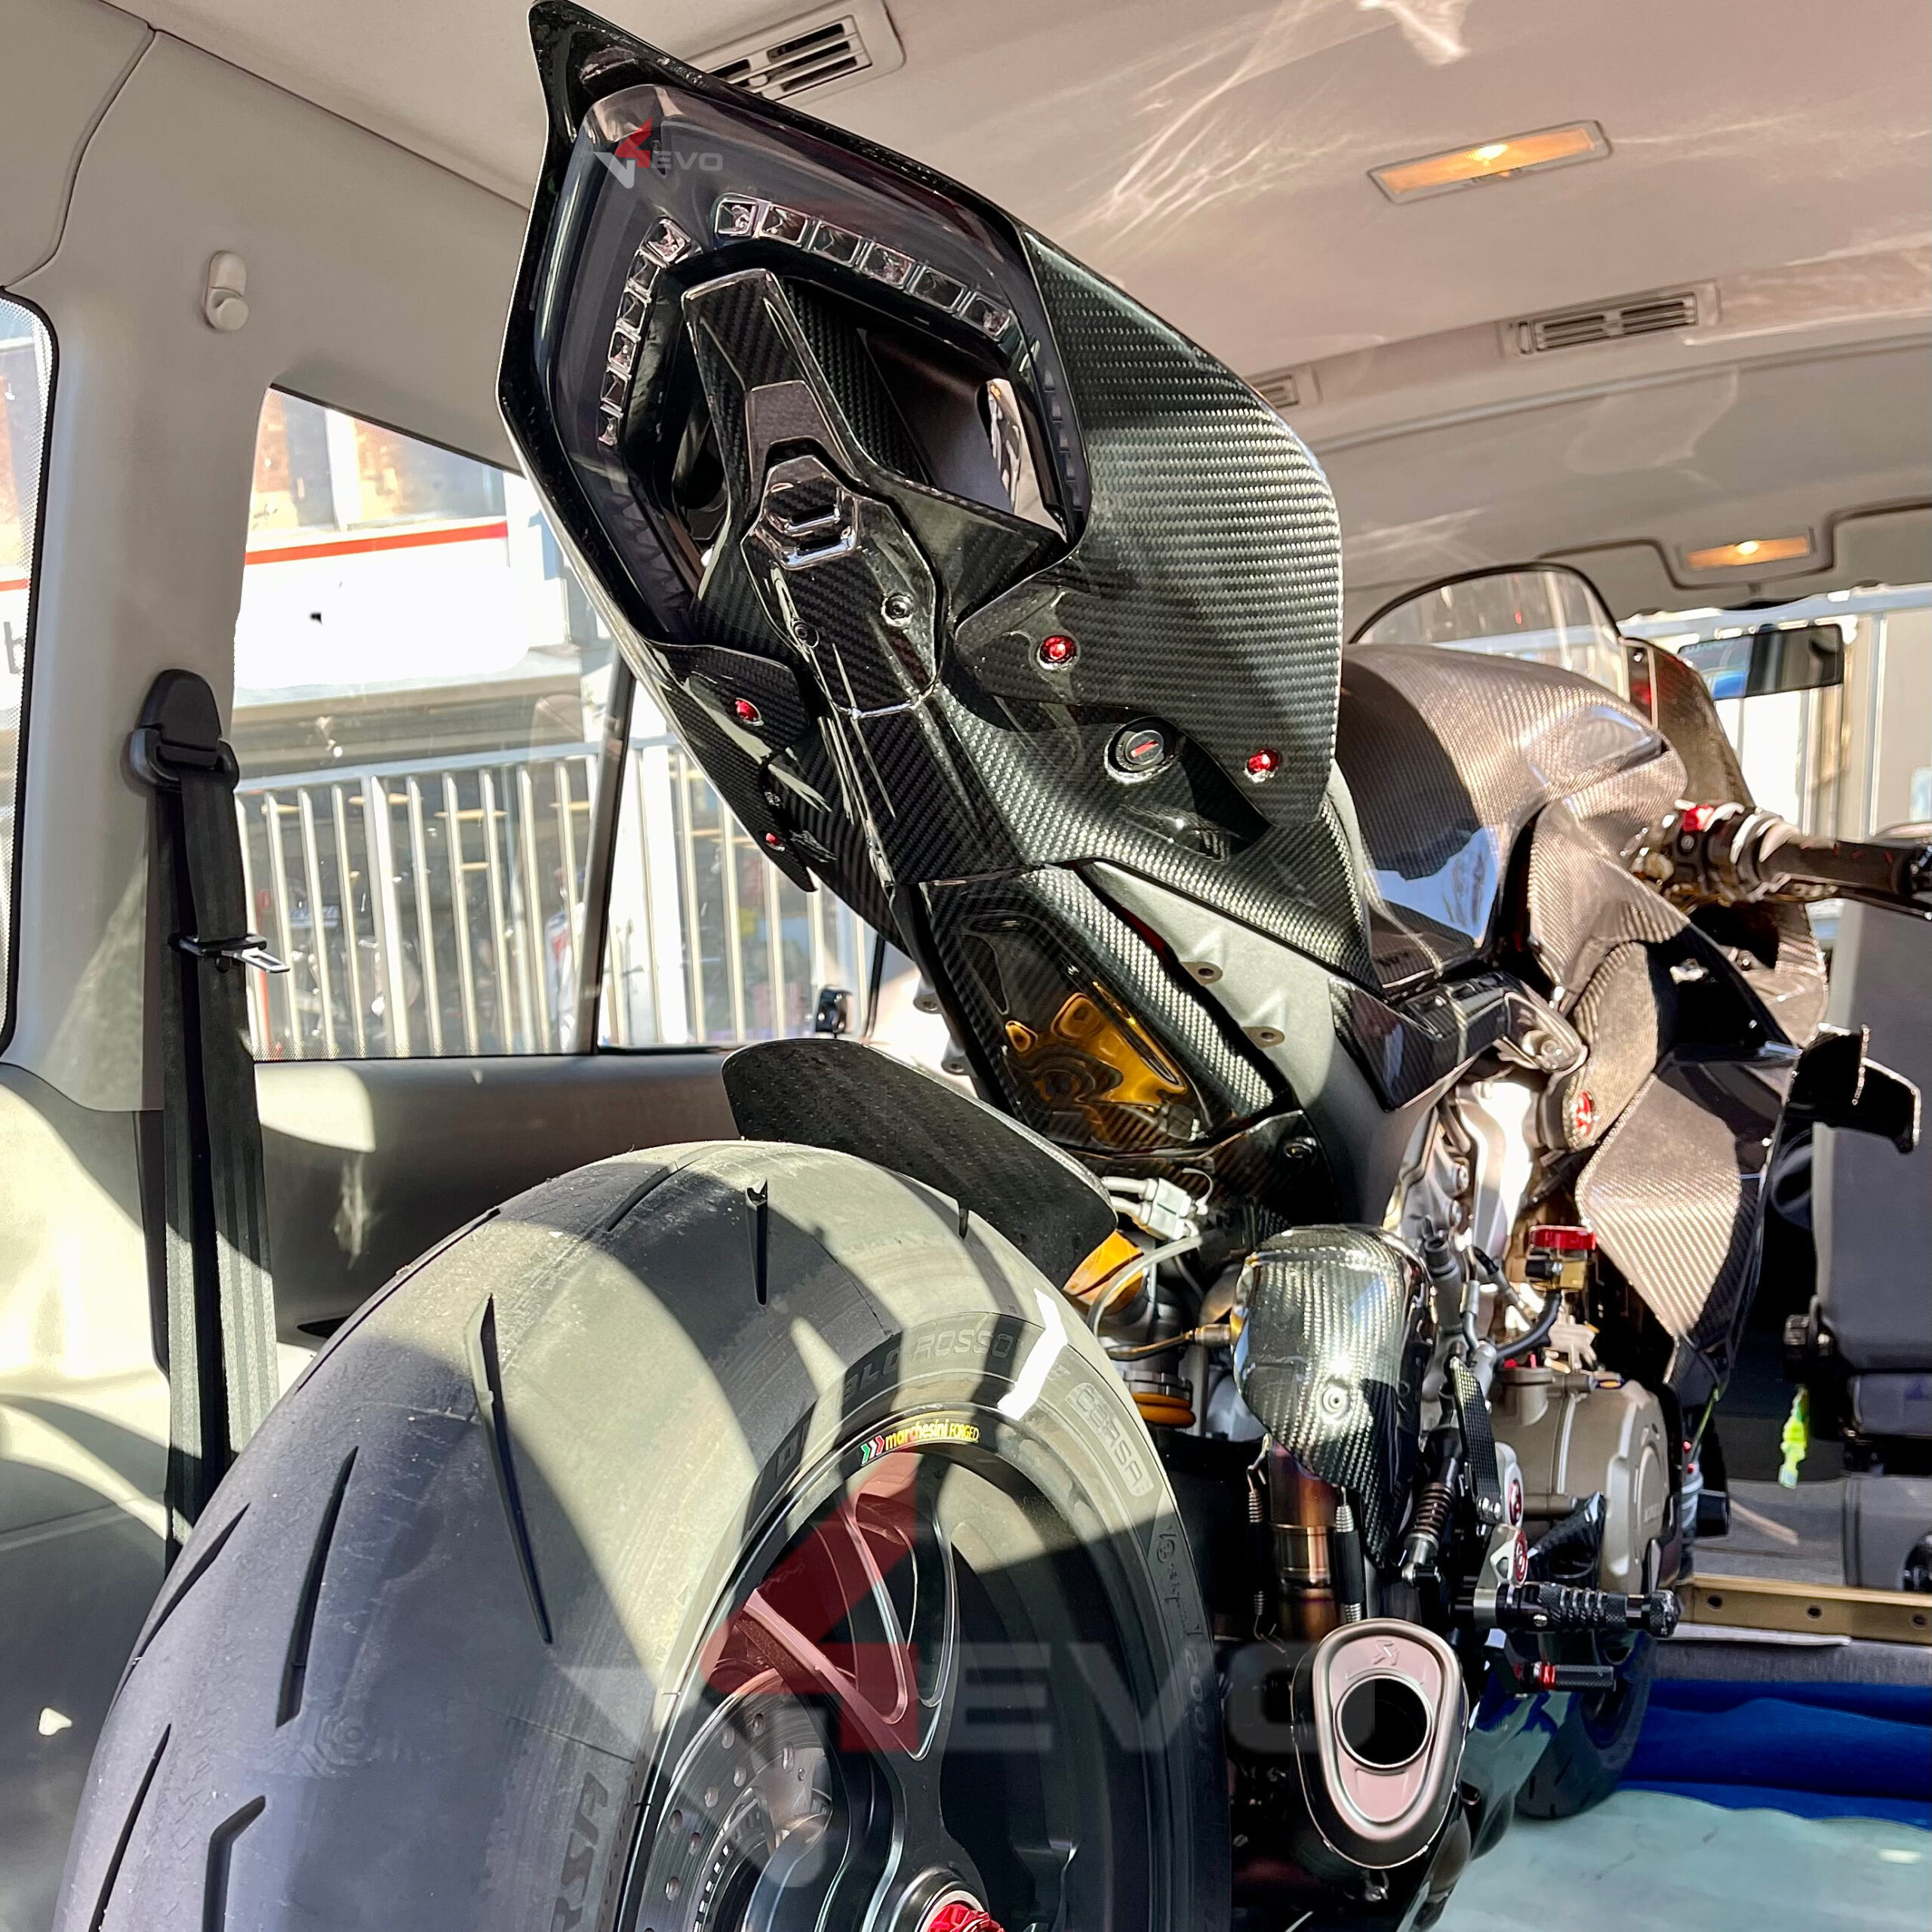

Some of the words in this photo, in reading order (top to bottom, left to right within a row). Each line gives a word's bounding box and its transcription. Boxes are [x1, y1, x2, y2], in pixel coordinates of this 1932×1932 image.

[885, 1418, 949, 1451] marchesini
[949, 1423, 980, 1443] FORGED
[912, 1328, 1014, 1362] ROSSO
[1075, 1384, 1143, 1488] CORSA
